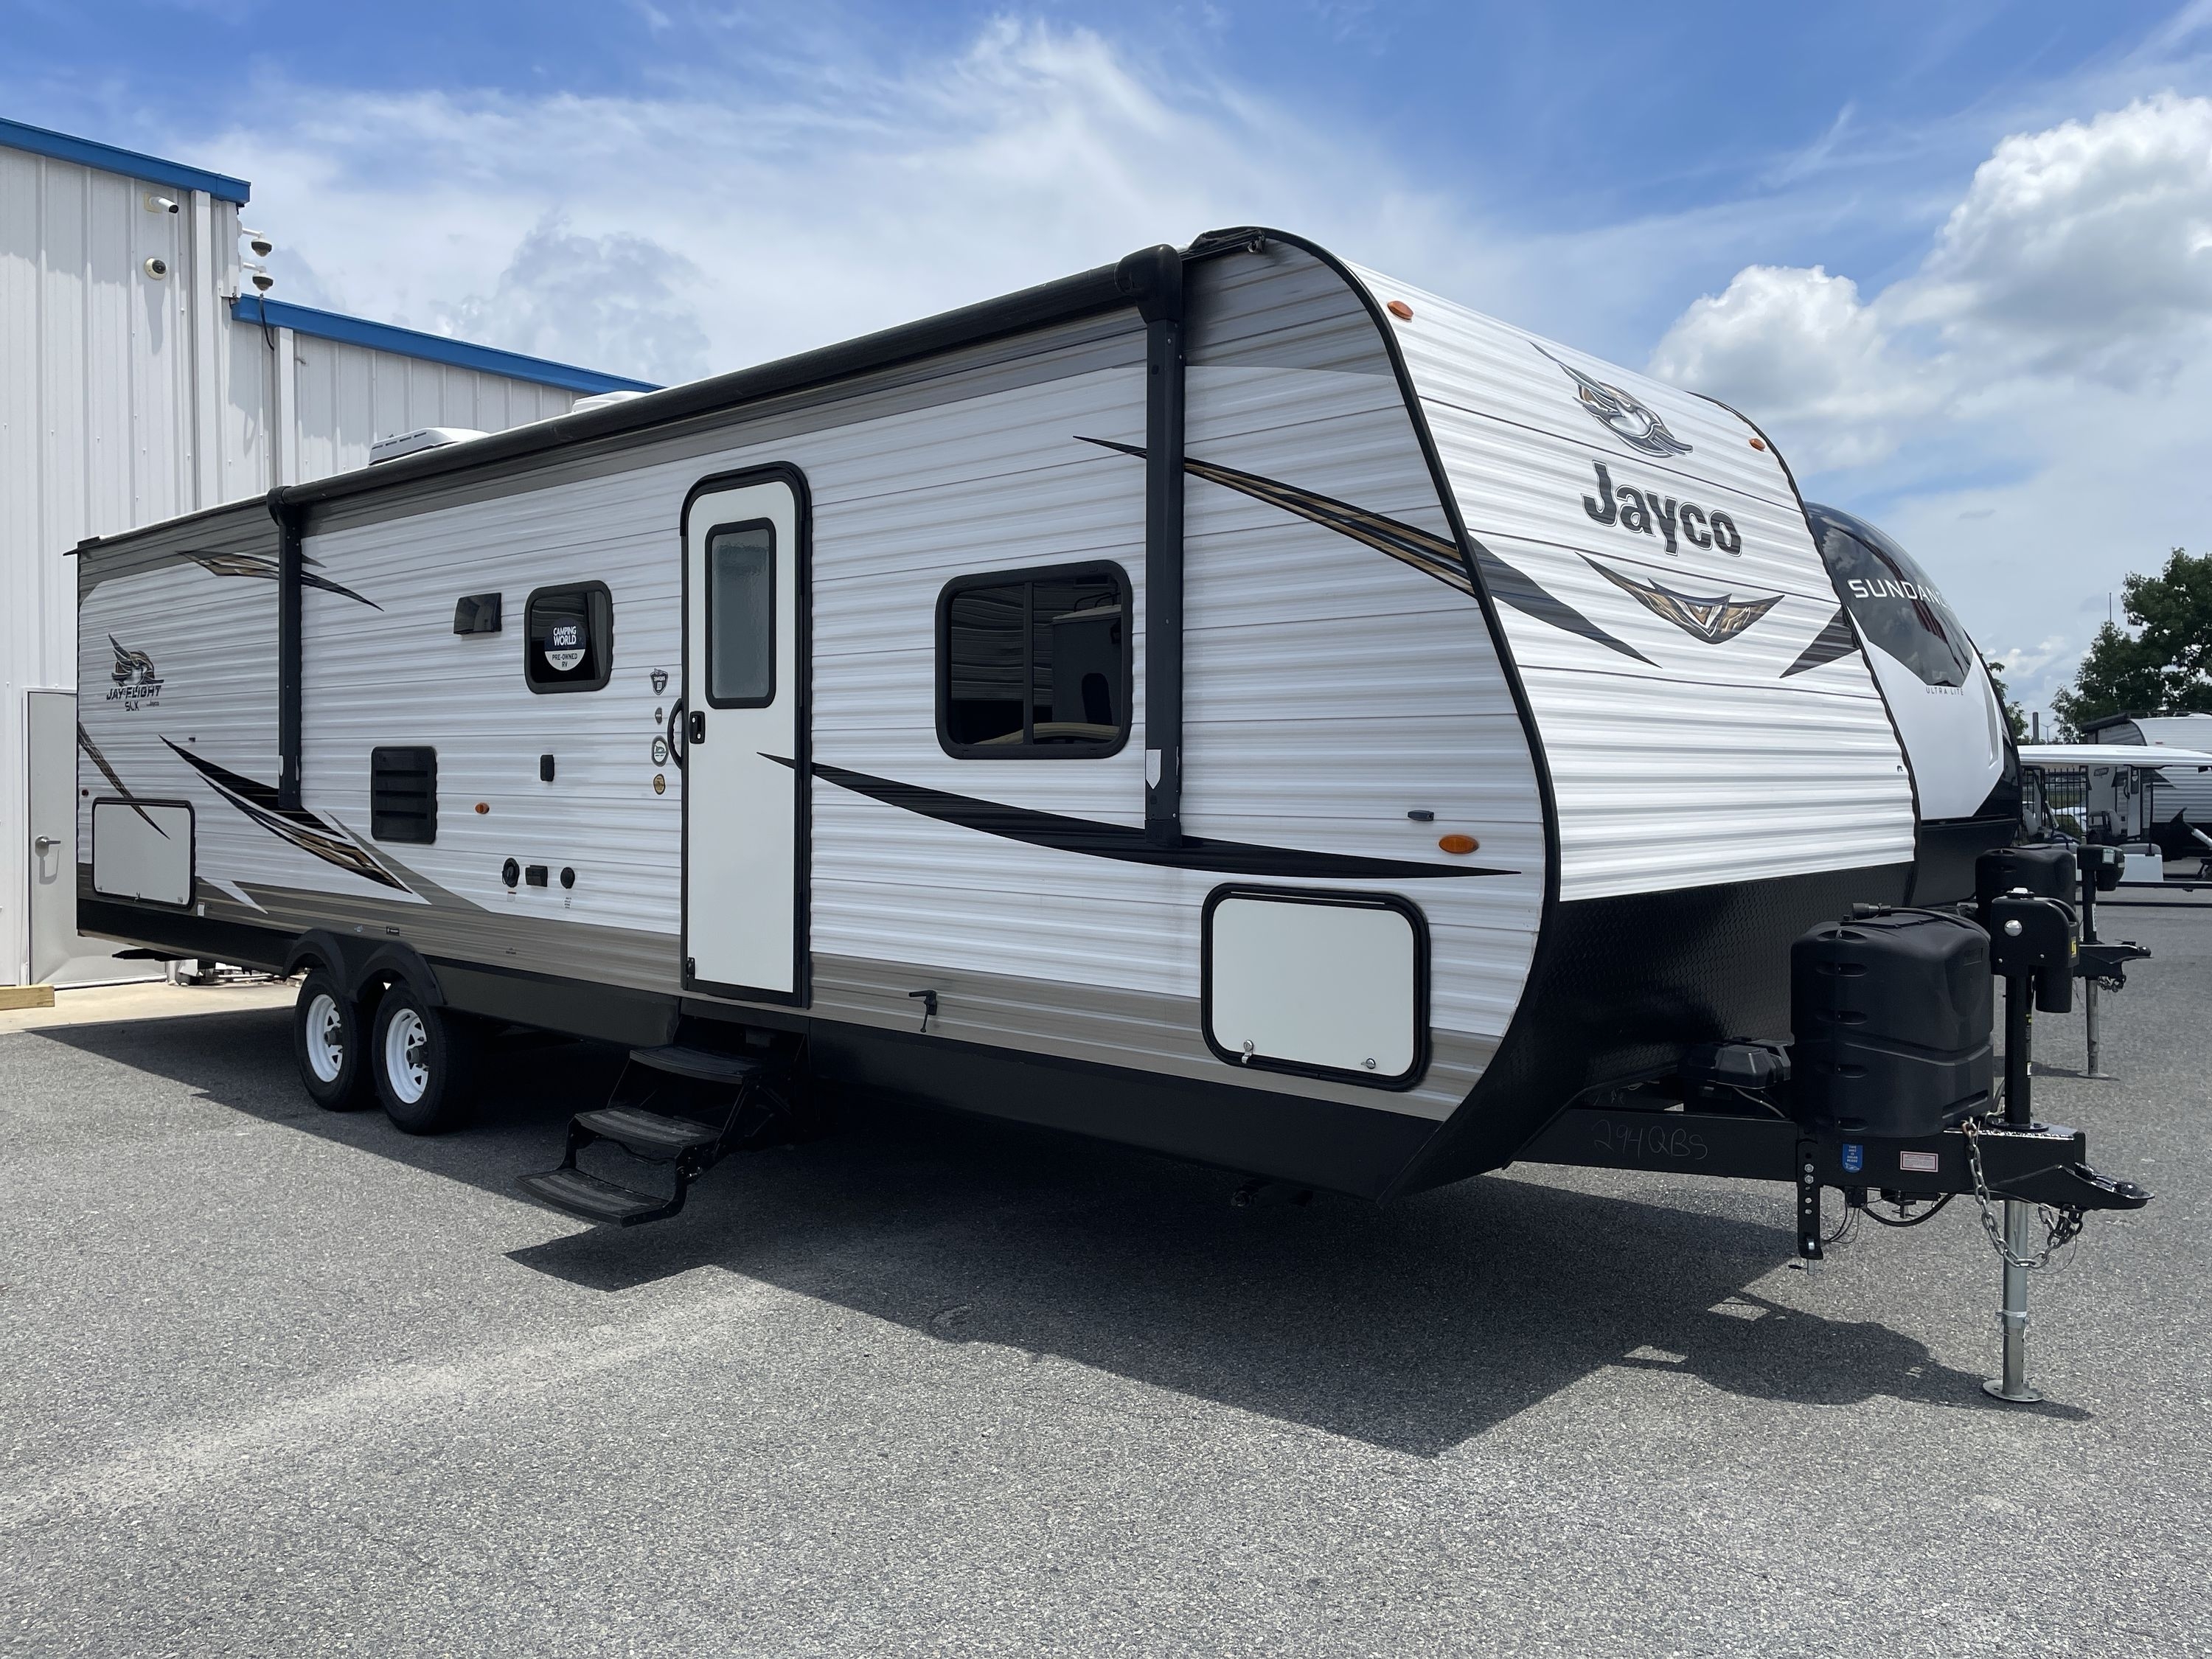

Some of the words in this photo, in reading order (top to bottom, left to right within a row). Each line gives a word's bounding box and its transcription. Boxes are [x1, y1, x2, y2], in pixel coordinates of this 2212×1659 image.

[1580, 459, 1743, 557] Jayco
[1847, 577, 1951, 609] SUNDANC
[553, 626, 577, 636] CAMPING
[553, 635, 577, 646] WORLD
[106, 688, 125, 700] JAY
[125, 685, 162, 699] FLIGHT
[1925, 686, 1948, 695] ULTRA
[1950, 687, 1964, 696] LITE
[125, 700, 140, 712] SLX
[1591, 1119, 1708, 1160] 294QBS
